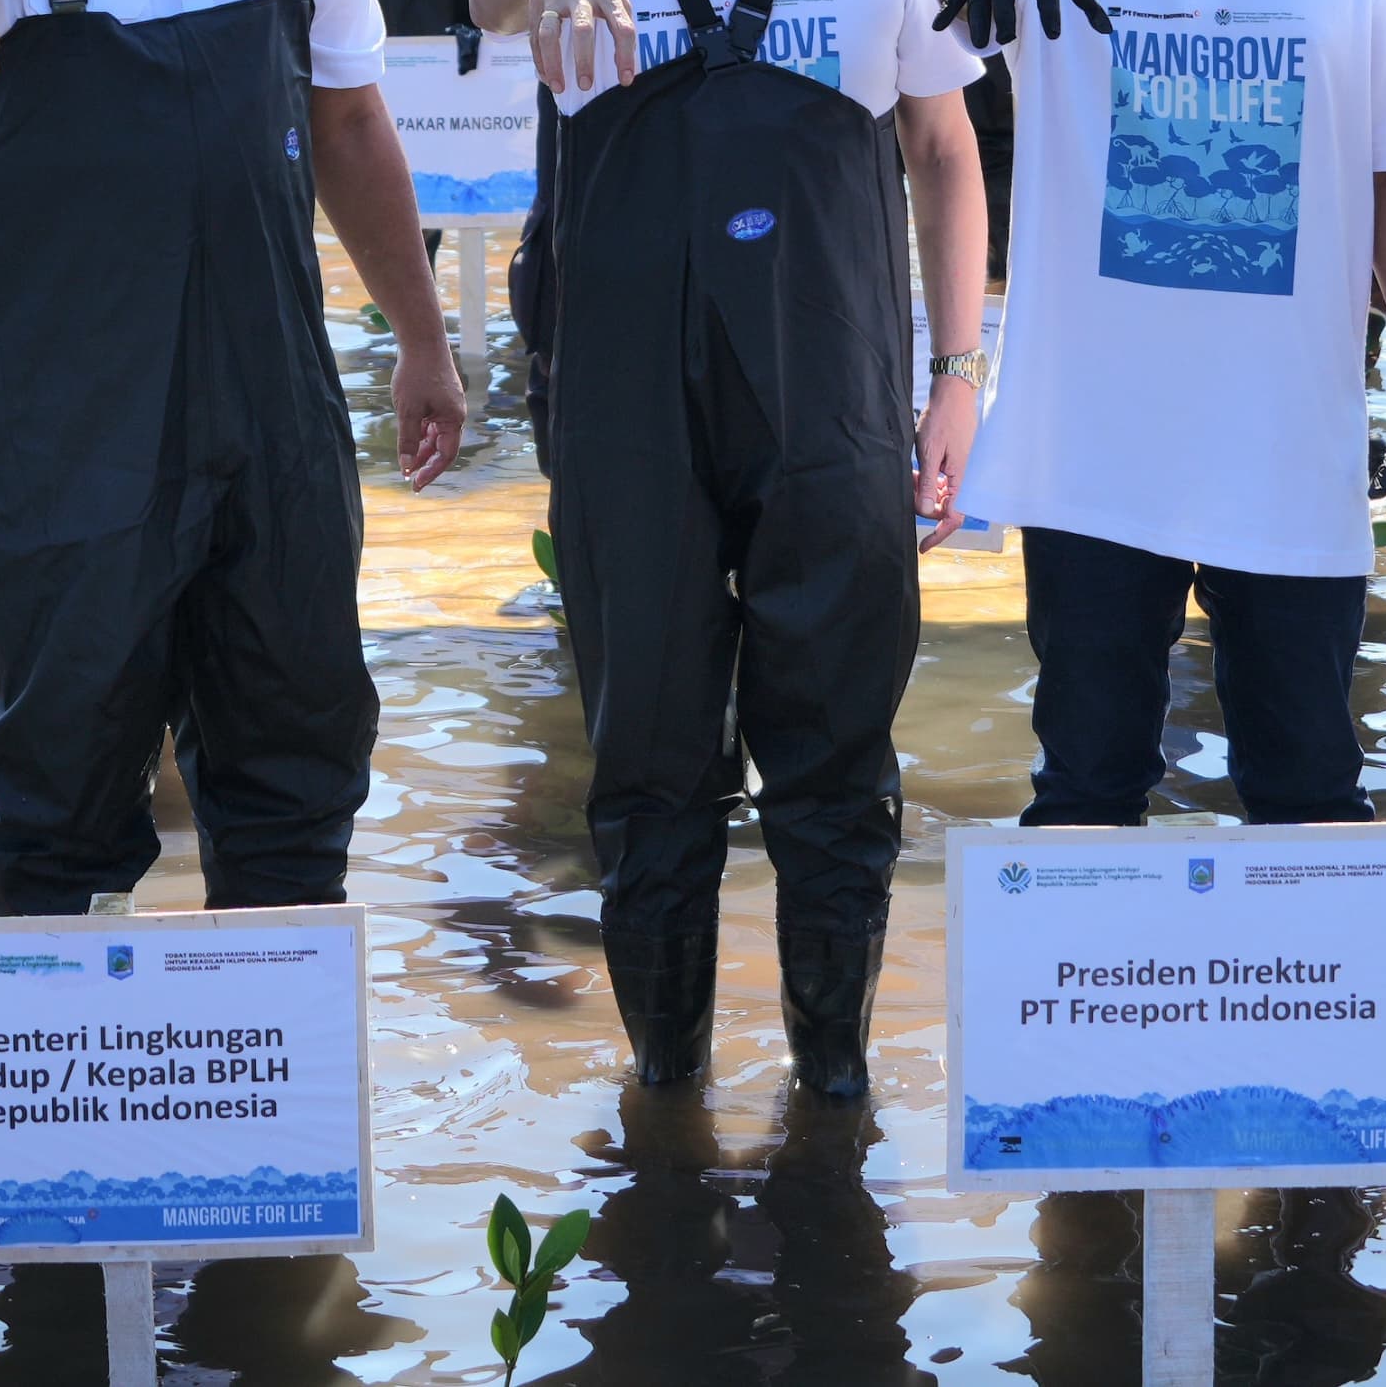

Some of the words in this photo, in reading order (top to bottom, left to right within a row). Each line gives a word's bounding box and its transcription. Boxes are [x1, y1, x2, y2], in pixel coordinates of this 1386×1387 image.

[1111, 30, 1307, 82] MANGROVE
[1132, 72, 1198, 120] FOR
[1209, 77, 1284, 125] LIFE
[397, 116, 445, 131] PAKAR
[450, 115, 533, 131] MANGROVE
[1058, 958, 1196, 987] Presiden
[1208, 957, 1341, 985] Direktur
[1021, 999, 1060, 1025] PT
[1070, 998, 1208, 1029] Freeport
[1220, 993, 1376, 1022] Indonesia
[100, 1023, 284, 1056] Lingkungan
[60, 1059, 76, 1093] /
[87, 1059, 195, 1092] Kepala
[207, 1057, 289, 1084] BPLH
[120, 1093, 278, 1122] Indonesia
[163, 1206, 252, 1227] MANGROVE
[256, 1204, 286, 1223] FOR
[290, 1203, 323, 1222] LIFE
